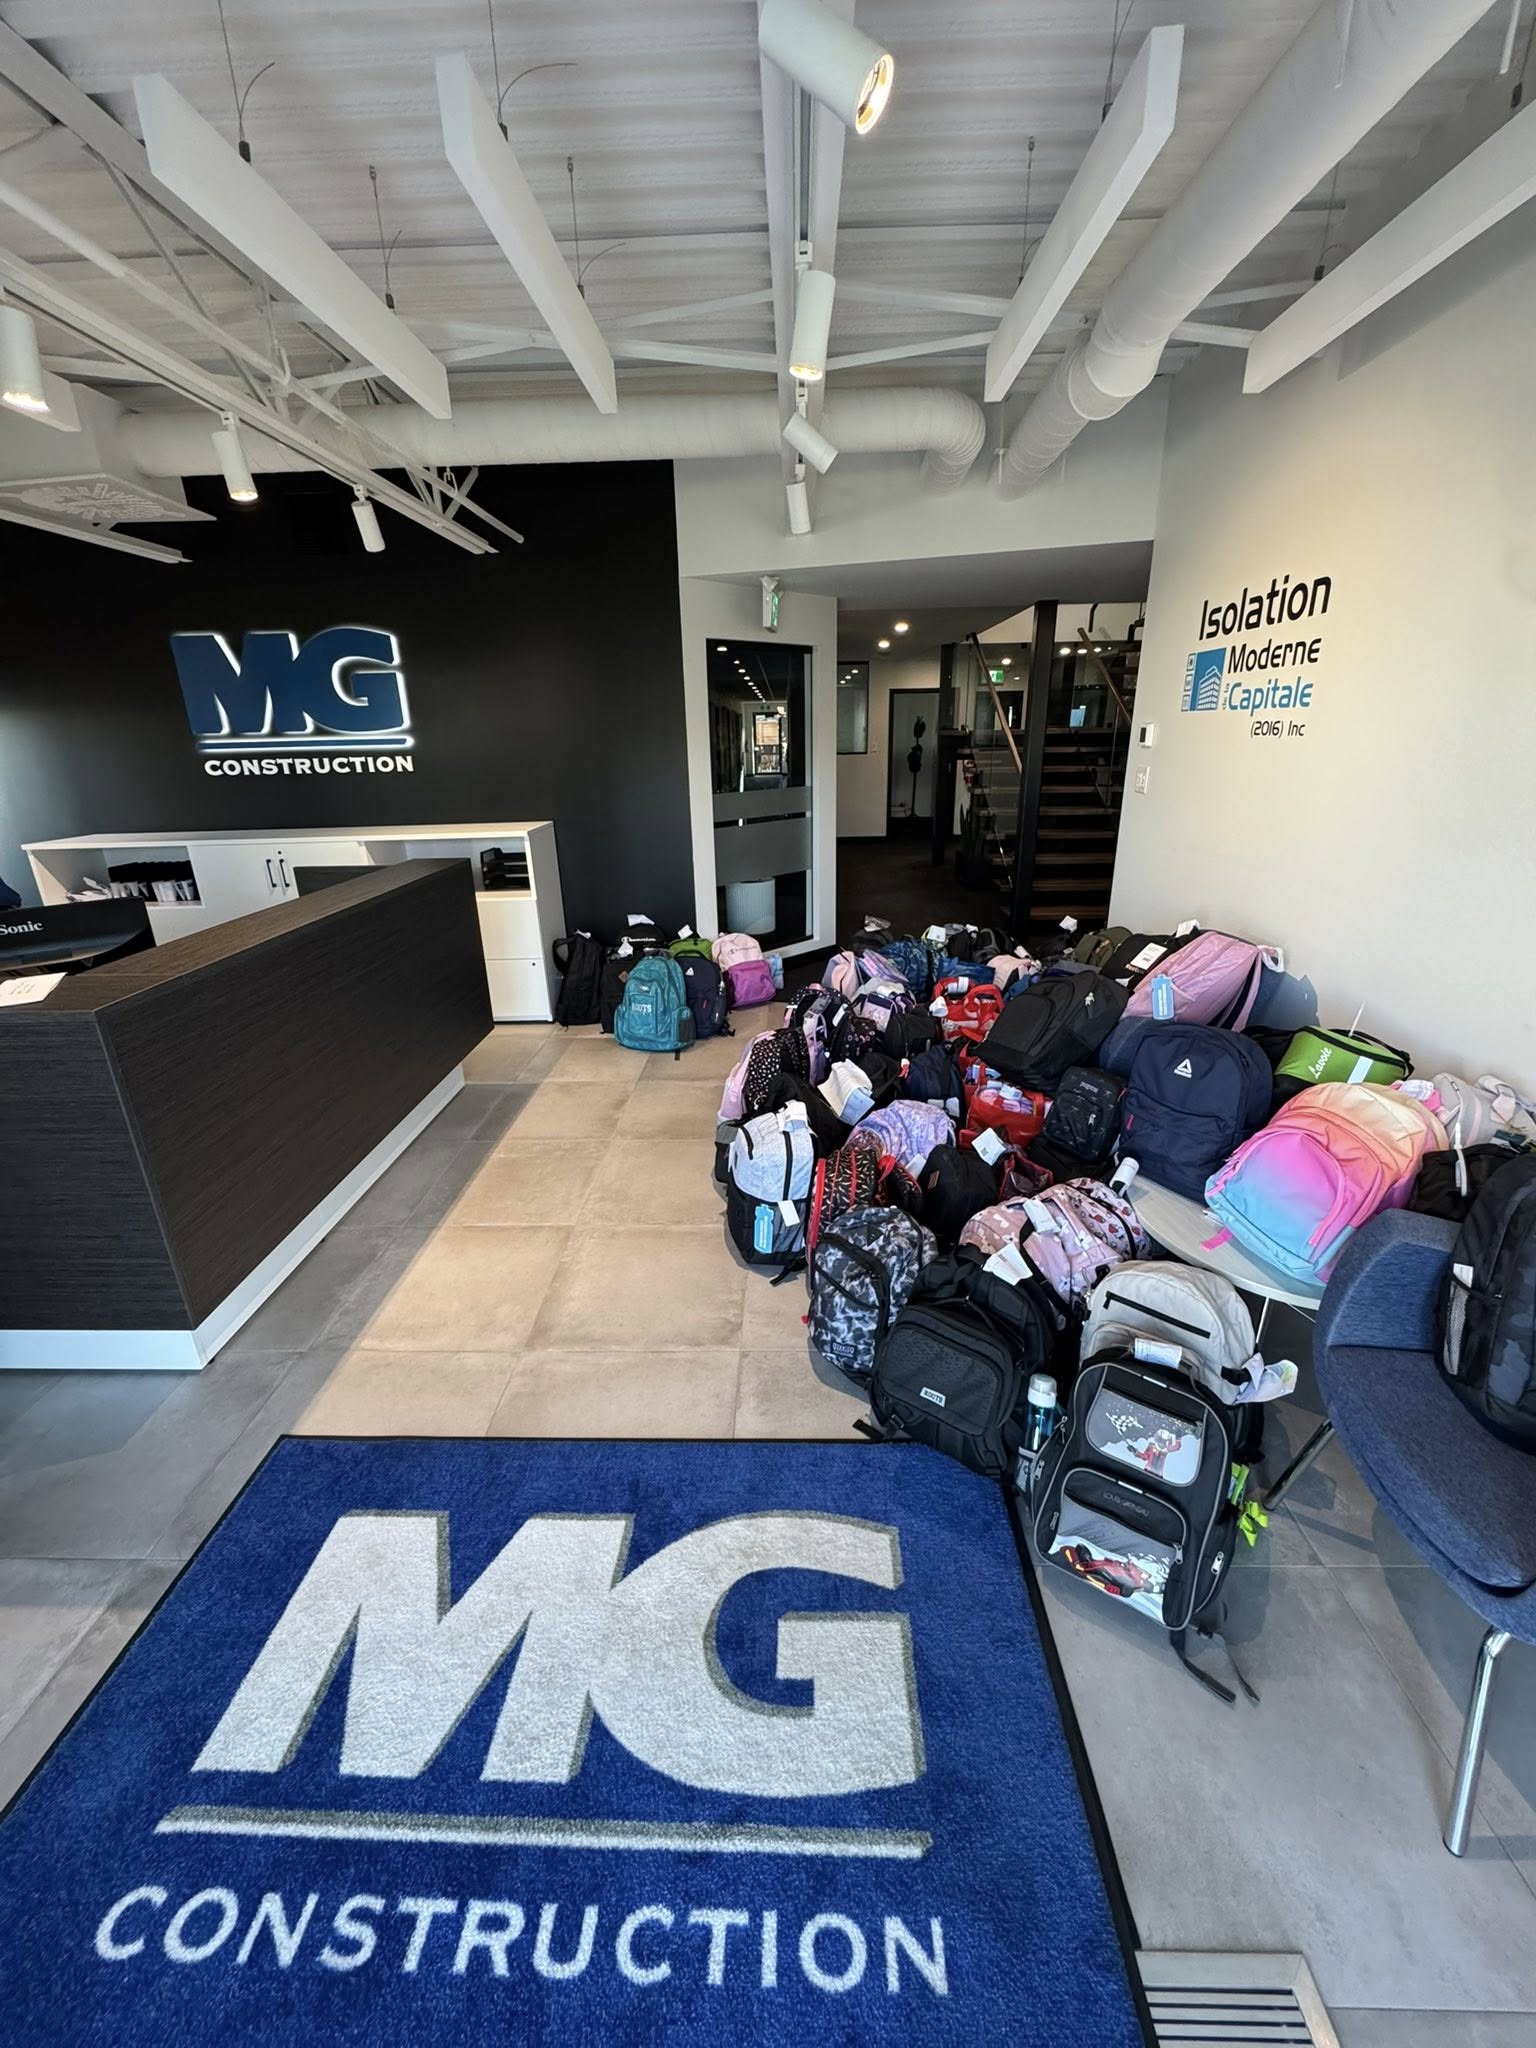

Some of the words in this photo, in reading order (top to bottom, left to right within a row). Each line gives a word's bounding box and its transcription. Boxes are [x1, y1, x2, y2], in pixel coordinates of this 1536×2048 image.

[1199, 574, 1332, 641] Isolation
[1227, 638, 1322, 674] Moderne
[170, 626, 411, 736] MG
[1228, 676, 1314, 717] Capitale
[1250, 720, 1284, 738] (2016)
[1287, 720, 1306, 736] Inc
[204, 755, 414, 776] CONSTRUCTION
[1308, 1047, 1332, 1079] Lavoie
[923, 1389, 944, 1404] ROOTS
[191, 1508, 927, 1798] MG
[94, 1885, 949, 1997] CONSTRUCTION
